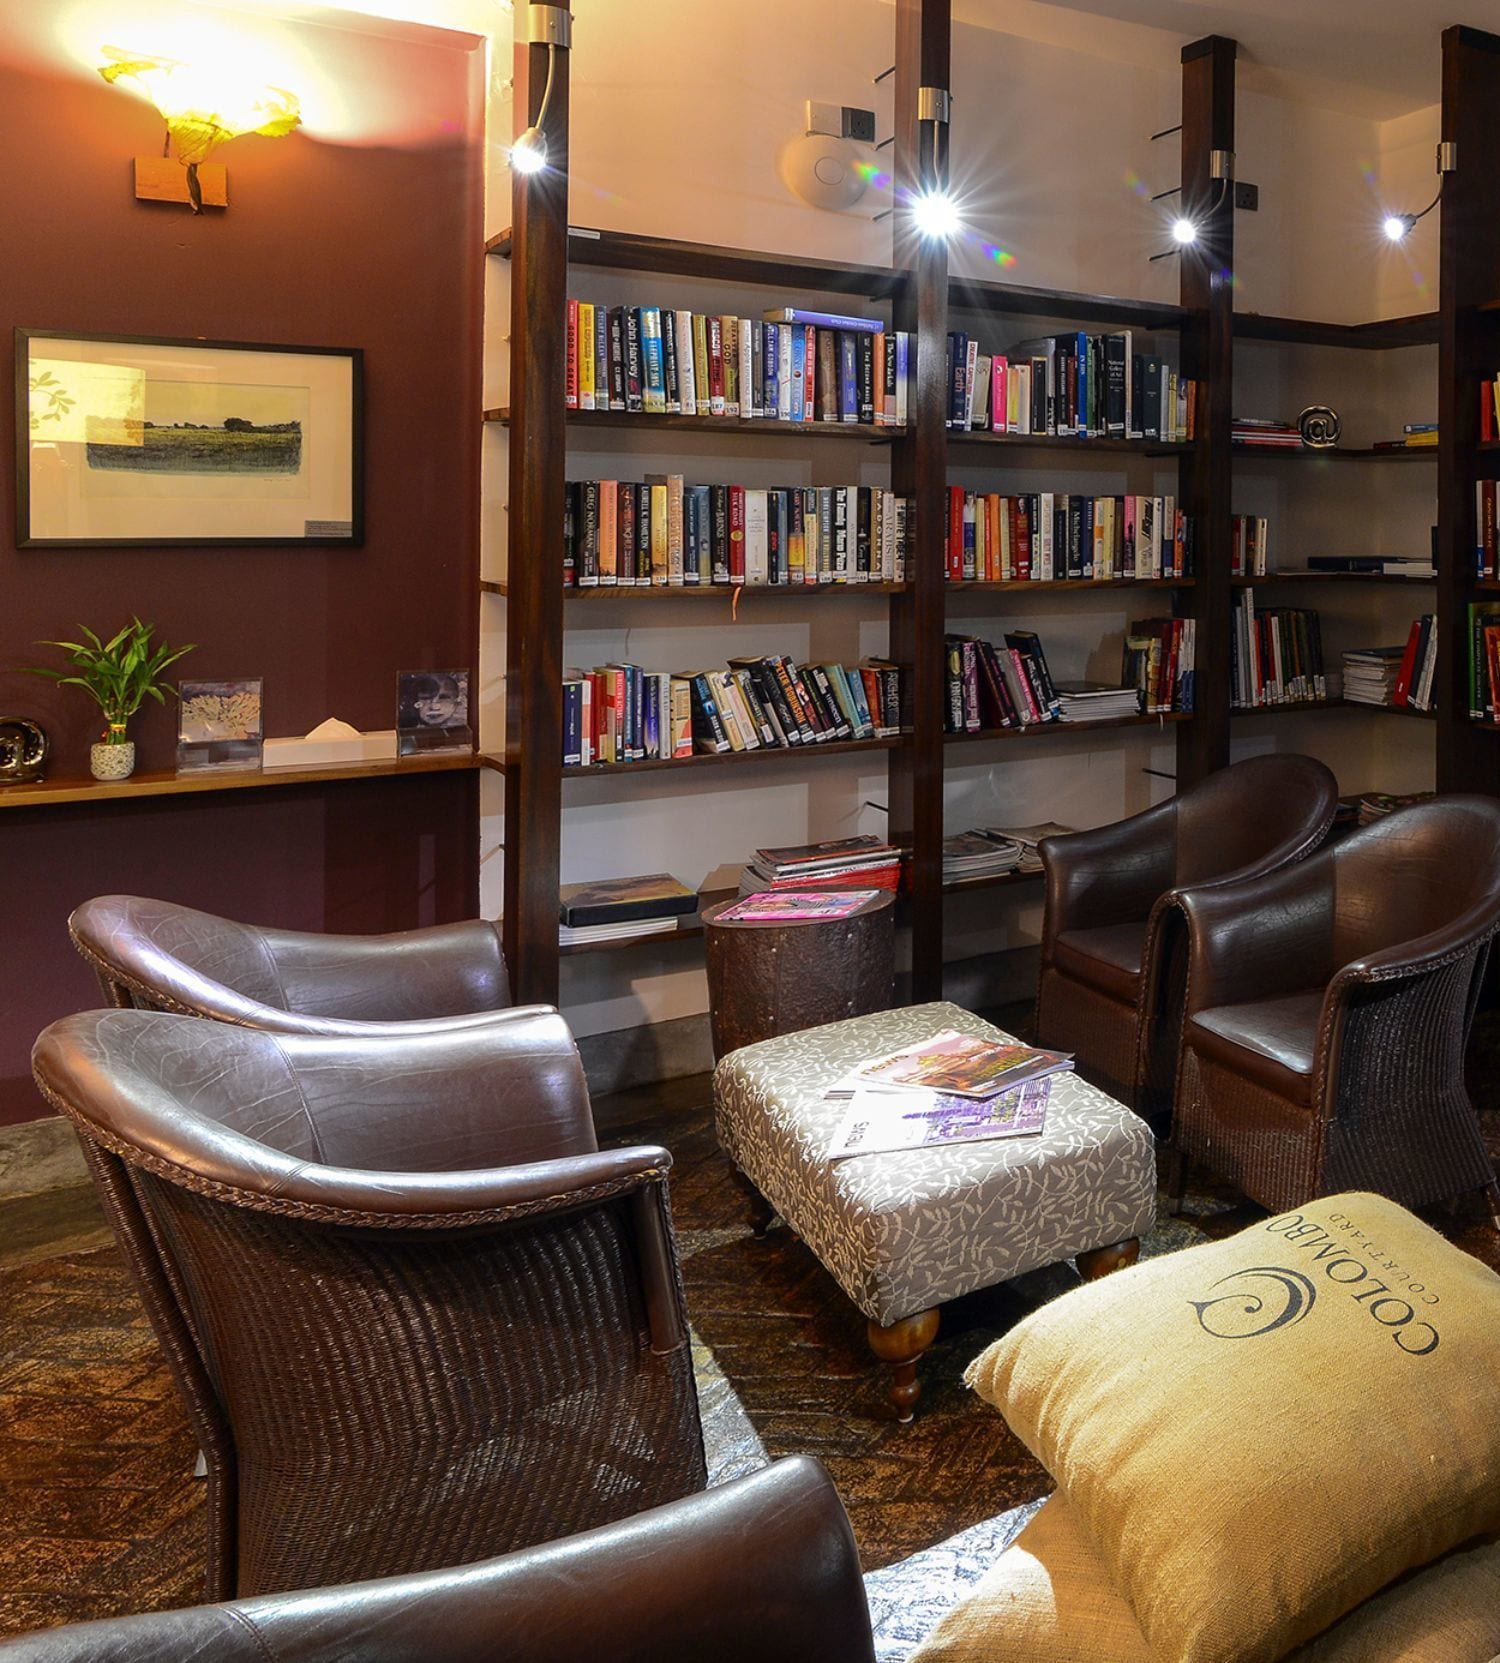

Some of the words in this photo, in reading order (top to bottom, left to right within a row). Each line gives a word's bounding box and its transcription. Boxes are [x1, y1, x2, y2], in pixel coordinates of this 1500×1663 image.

[649, 341, 658, 370] ELEPHANT
[711, 321, 721, 357] MOSCOW
[627, 343, 638, 378] Harvey
[953, 366, 965, 393] Earth
[584, 512, 595, 548] NORMAN
[835, 502, 845, 526] Family
[1070, 510, 1080, 560] Michelangelo
[773, 661, 790, 687] PETER
[784, 685, 806, 725] ROBINSON
[824, 694, 842, 724] unseen
[1329, 1213, 1440, 1305] COURTYARD
[1265, 1215, 1440, 1356] COLOMBO
